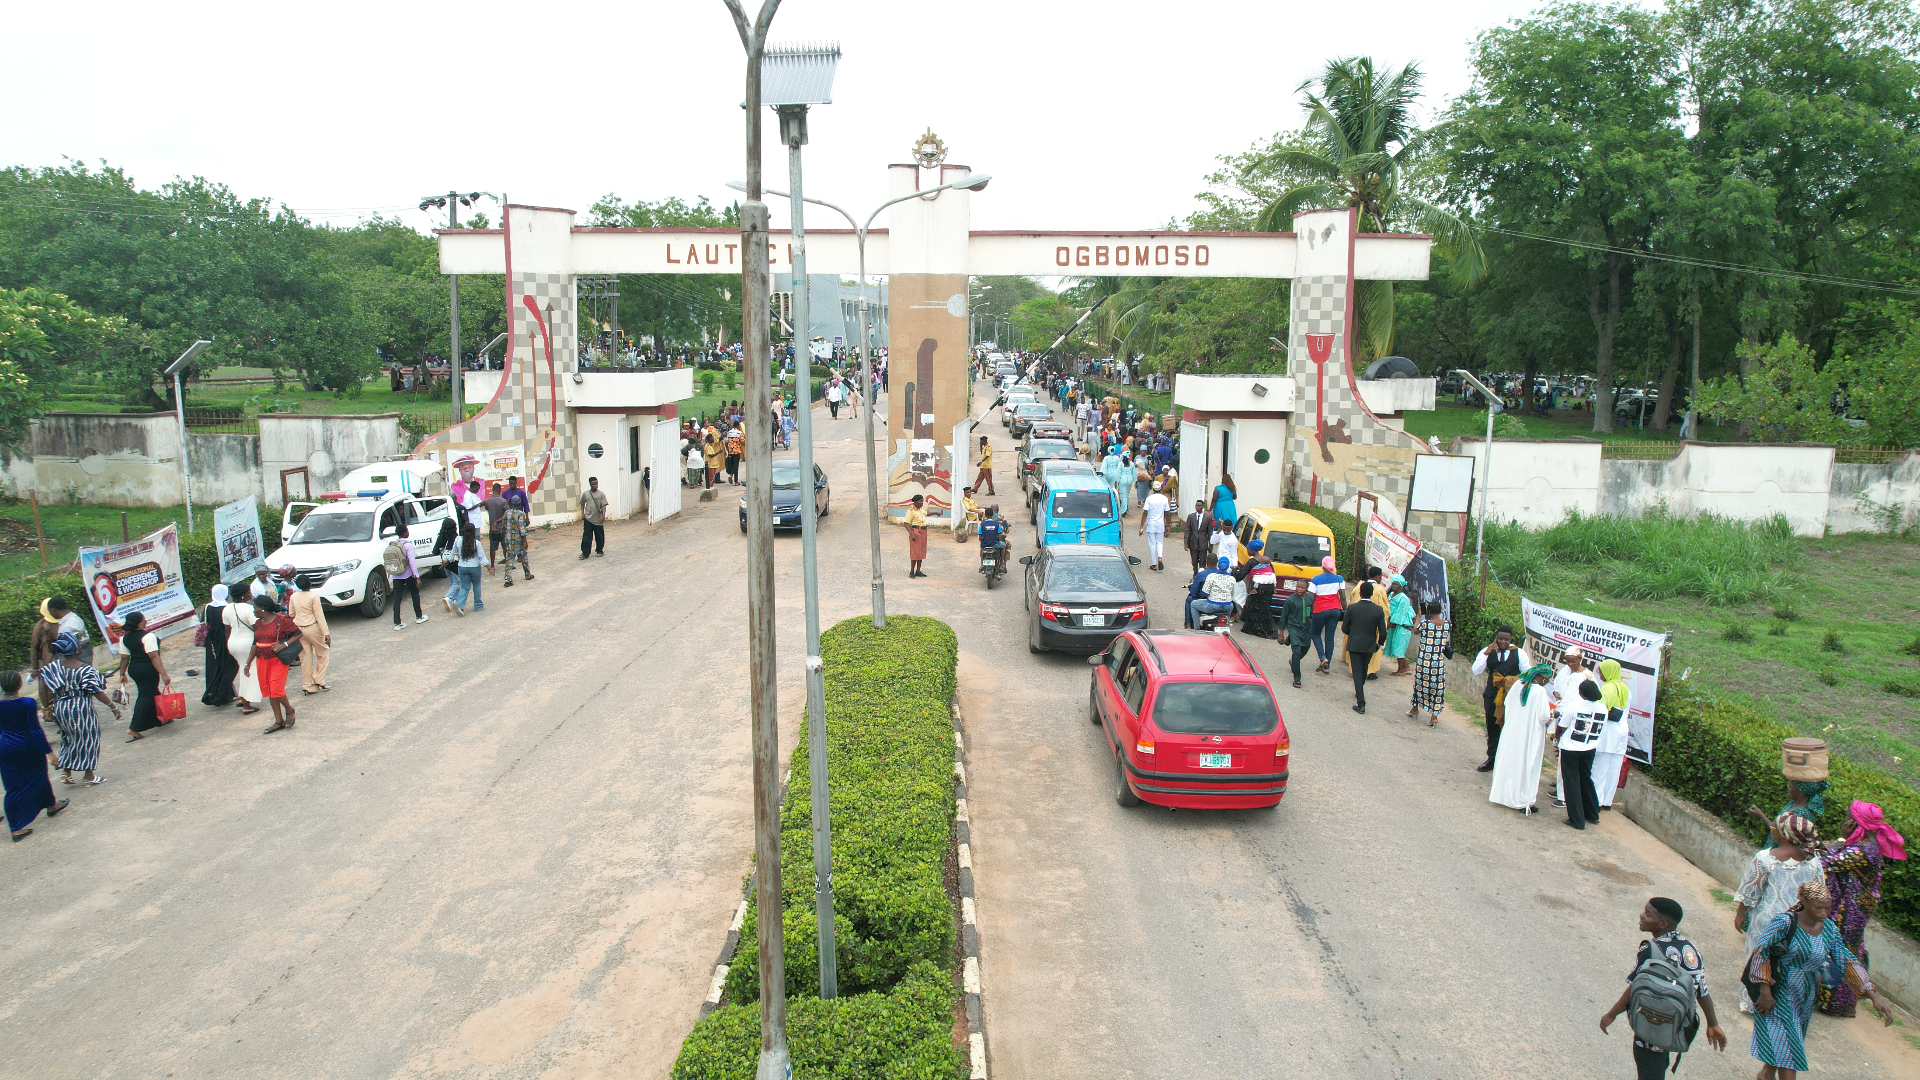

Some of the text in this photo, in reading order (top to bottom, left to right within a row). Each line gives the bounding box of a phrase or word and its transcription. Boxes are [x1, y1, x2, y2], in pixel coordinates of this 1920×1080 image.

[667, 243, 791, 266] LAUTC
[1056, 244, 1210, 267] OGBOMOSO
[413, 537, 433, 546] FORCE
[116, 564, 156, 579] INTERNATIONAL
[116, 569, 158, 588] CONFERENCE
[97, 578, 112, 607] 6
[117, 587, 123, 595] &
[122, 576, 159, 594] WORKSHOP
[1532, 607, 1552, 620] LADOKE
[1551, 613, 1584, 631] AKINTOLA
[1586, 624, 1638, 644] UNIVERSITY
[1639, 638, 1653, 648] OF
[1542, 619, 1582, 639] TECHNOLOGY
[1582, 633, 1626, 653] (LAUTECH)
